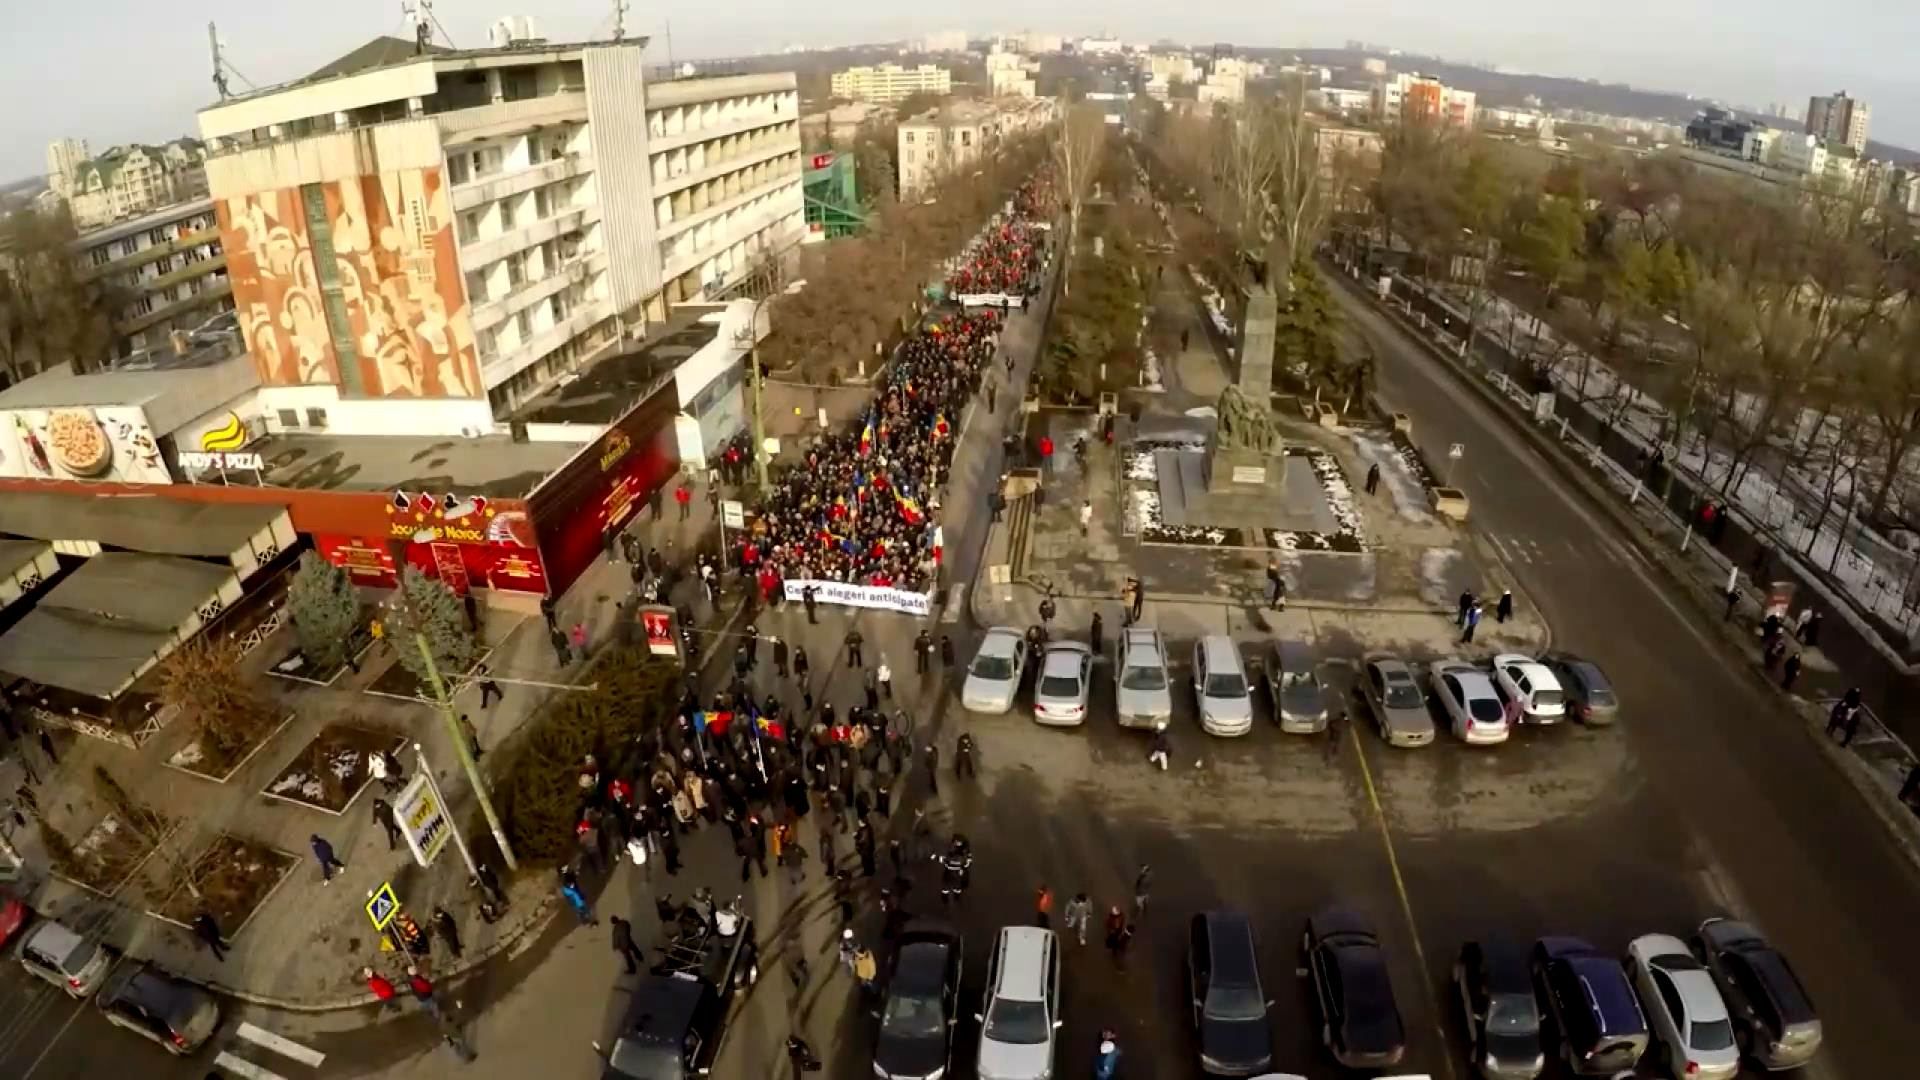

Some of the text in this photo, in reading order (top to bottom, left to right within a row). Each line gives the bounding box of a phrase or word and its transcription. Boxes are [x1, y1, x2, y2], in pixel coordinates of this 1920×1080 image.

[225, 453, 264, 470] PIZZA
[444, 525, 483, 541] Noroc
[827, 587, 865, 601] alegeri
